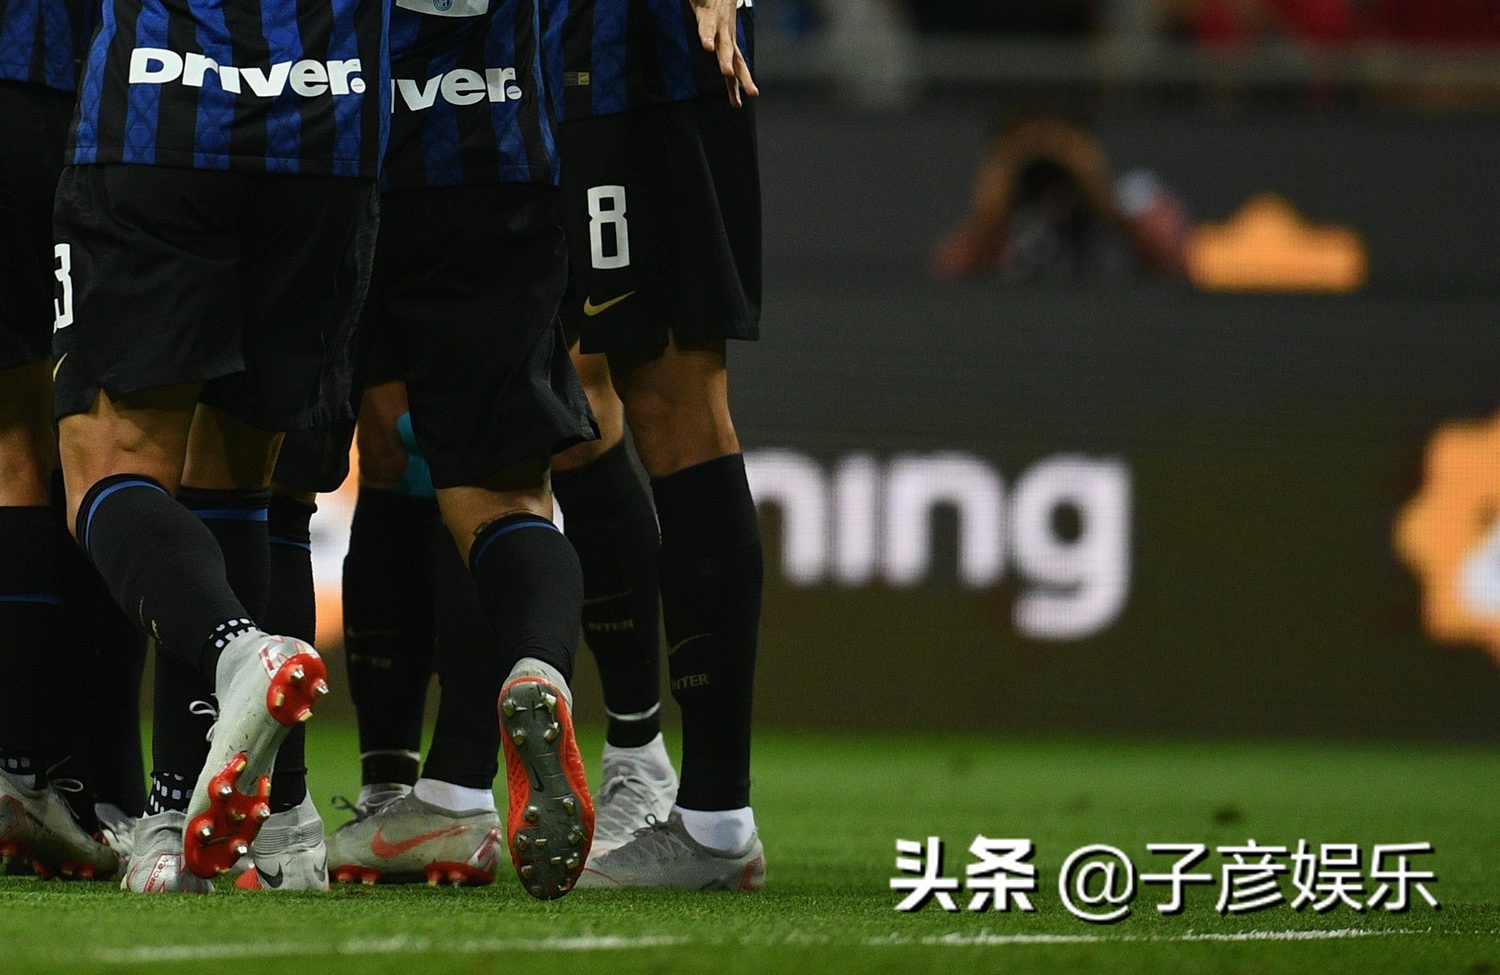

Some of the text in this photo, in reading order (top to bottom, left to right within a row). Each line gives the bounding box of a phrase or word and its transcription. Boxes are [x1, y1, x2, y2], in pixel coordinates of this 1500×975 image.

[588, 185, 630, 269] 8
[53, 243, 74, 334] 3
[743, 448, 1132, 640] ning
[670, 673, 709, 691] NTER
